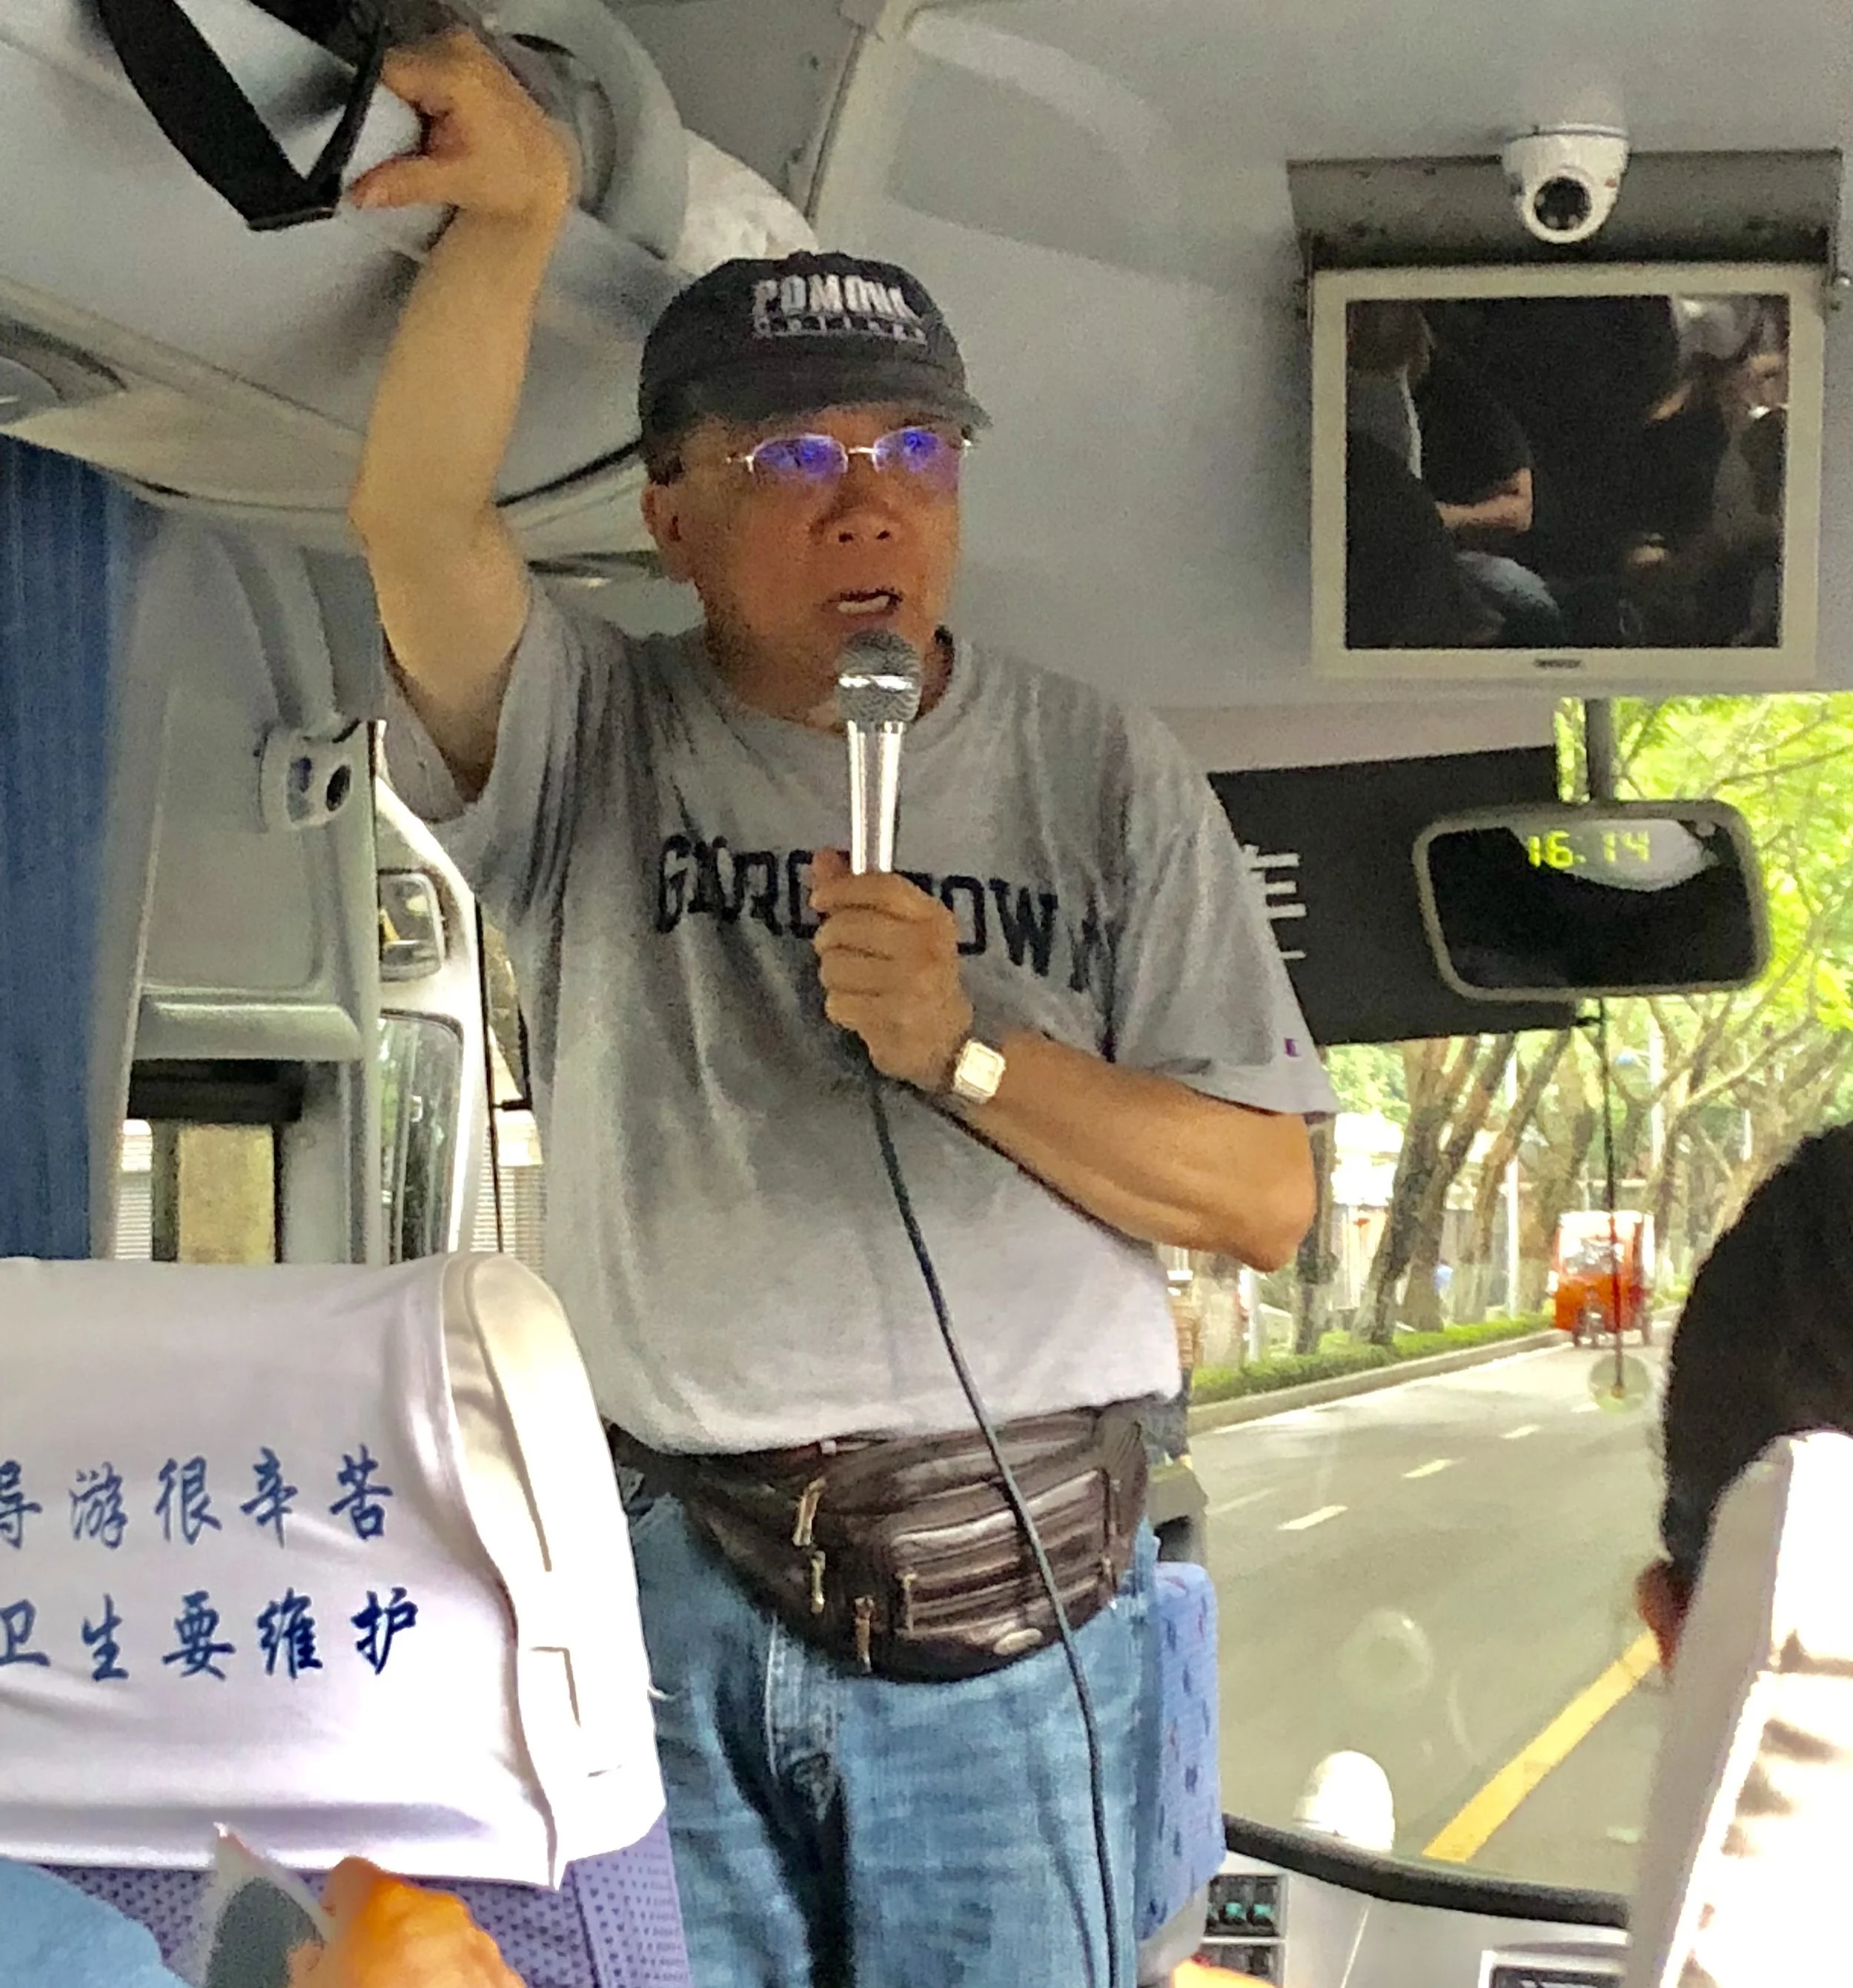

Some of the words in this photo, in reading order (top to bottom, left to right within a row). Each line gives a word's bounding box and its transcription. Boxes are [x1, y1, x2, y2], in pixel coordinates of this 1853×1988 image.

[751, 274, 924, 326] POMONA
[0, 1443, 394, 1551] 导游很辛苦
[0, 1586, 419, 1682] 卫生要维护
